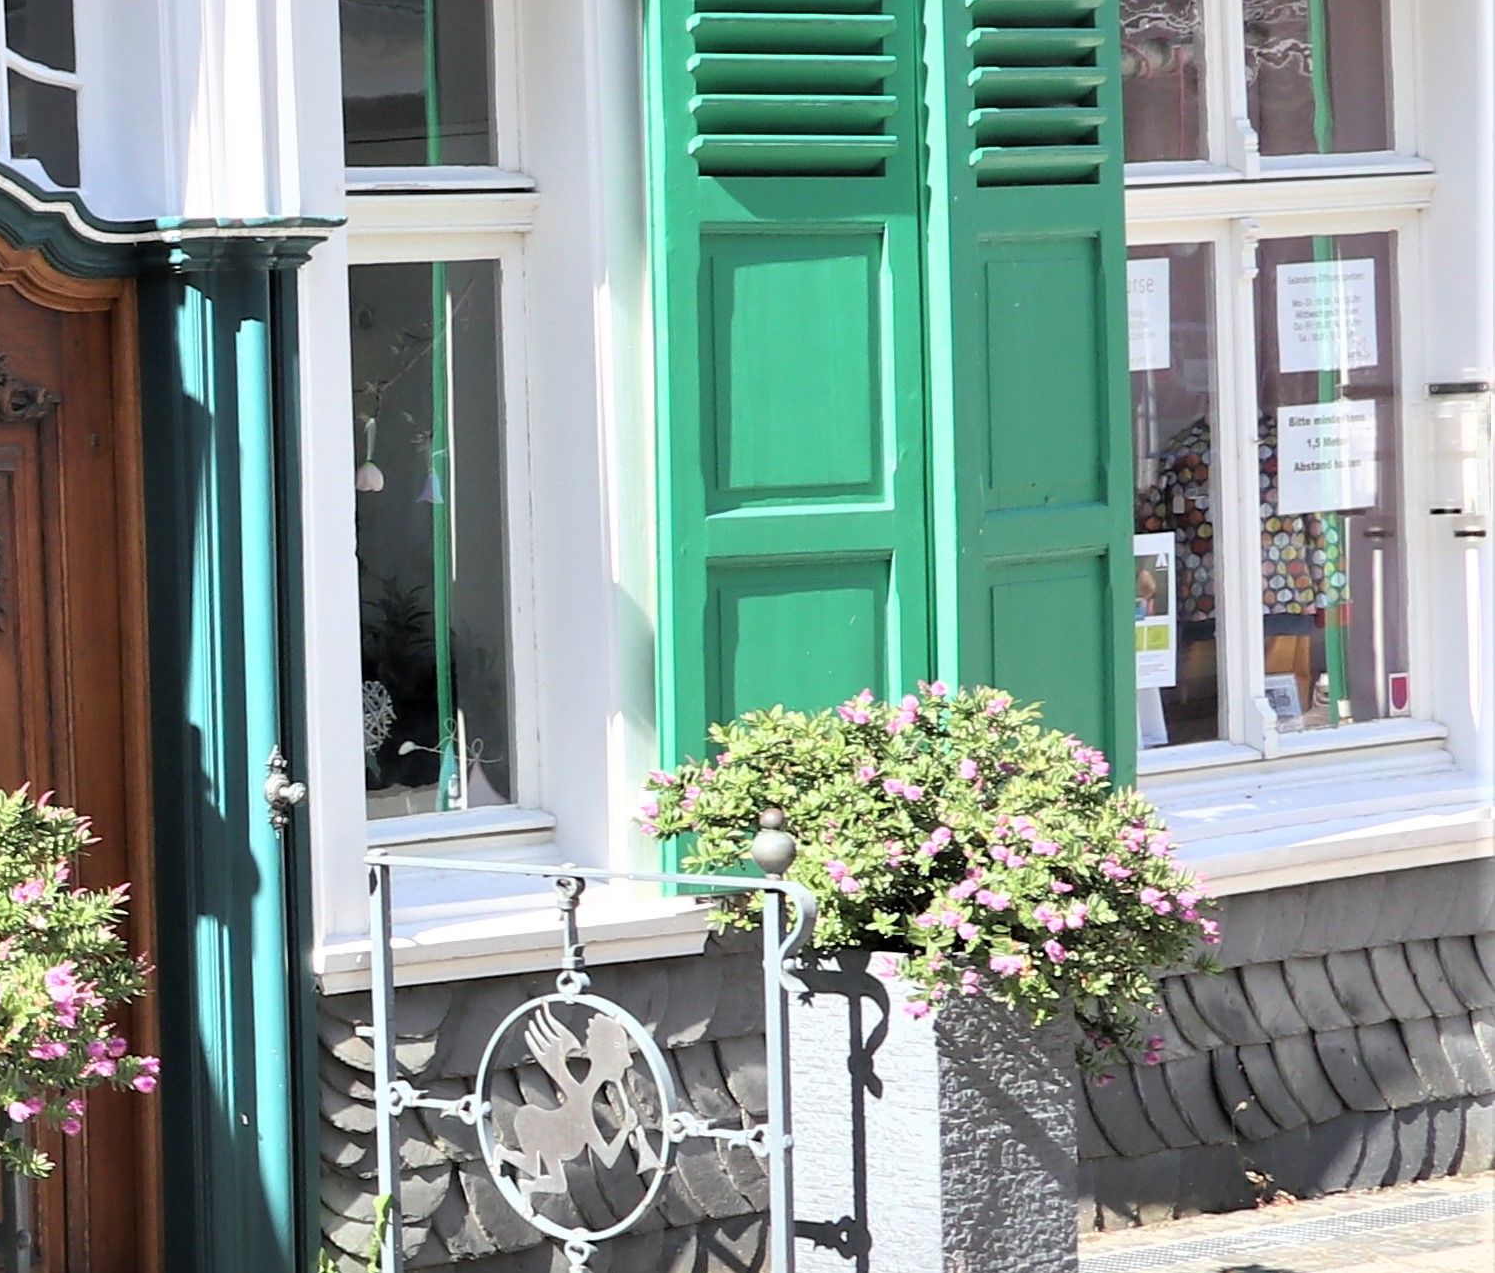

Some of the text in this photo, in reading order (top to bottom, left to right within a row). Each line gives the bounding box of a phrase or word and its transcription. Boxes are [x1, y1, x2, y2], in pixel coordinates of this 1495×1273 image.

[1289, 416, 1311, 427] Bitte
[1307, 438, 1320, 450] 1,5
[1294, 461, 1332, 472] Abstand
